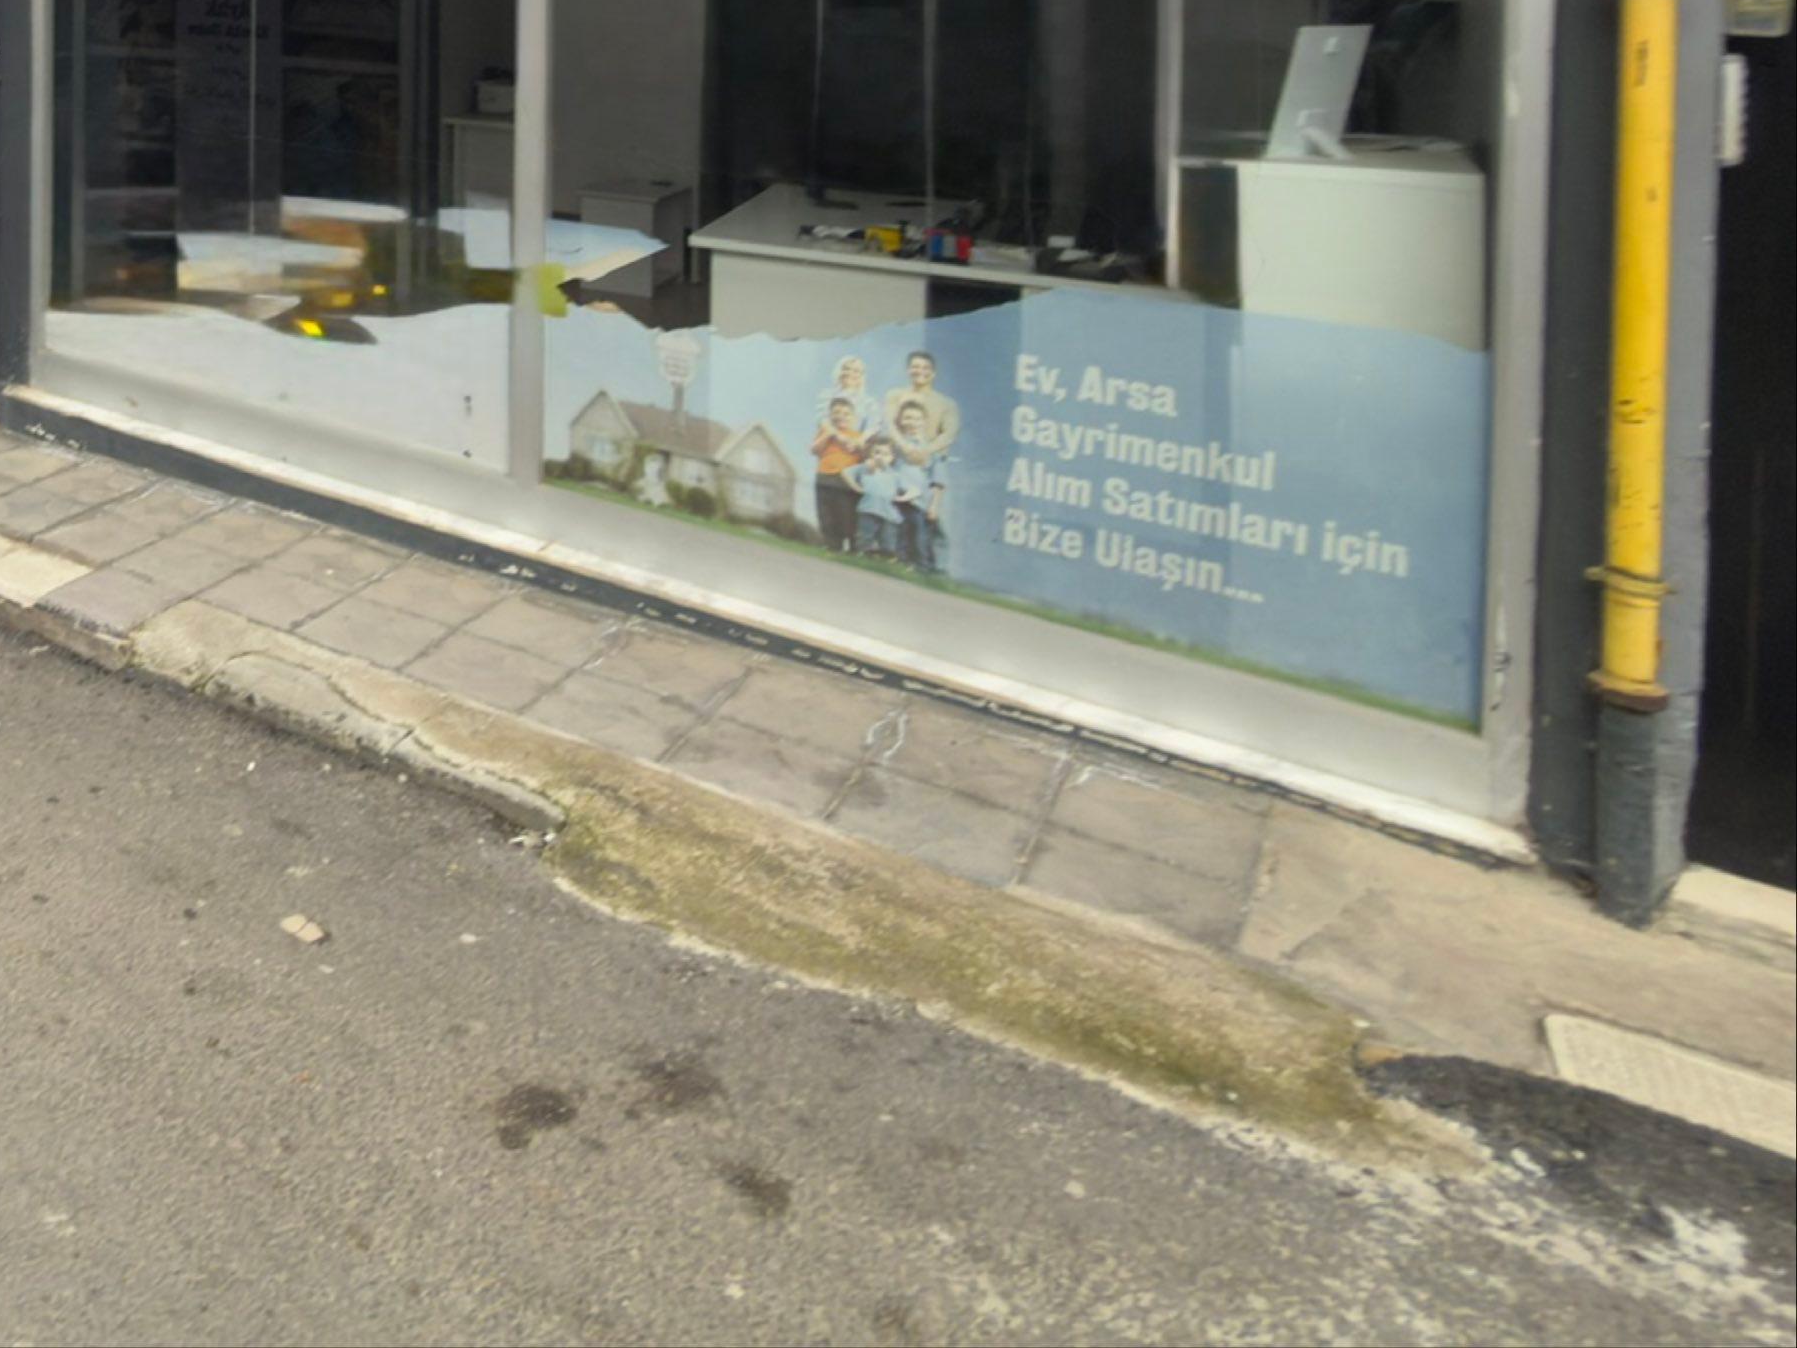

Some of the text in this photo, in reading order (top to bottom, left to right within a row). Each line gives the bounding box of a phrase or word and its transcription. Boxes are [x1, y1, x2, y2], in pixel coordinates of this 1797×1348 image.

[1014, 353, 1178, 417] Ev, Arsa
[1011, 405, 1277, 491] Gayrimenkul
[1004, 508, 1084, 559] Bize
[1006, 457, 1410, 577] Alım Satımları için
